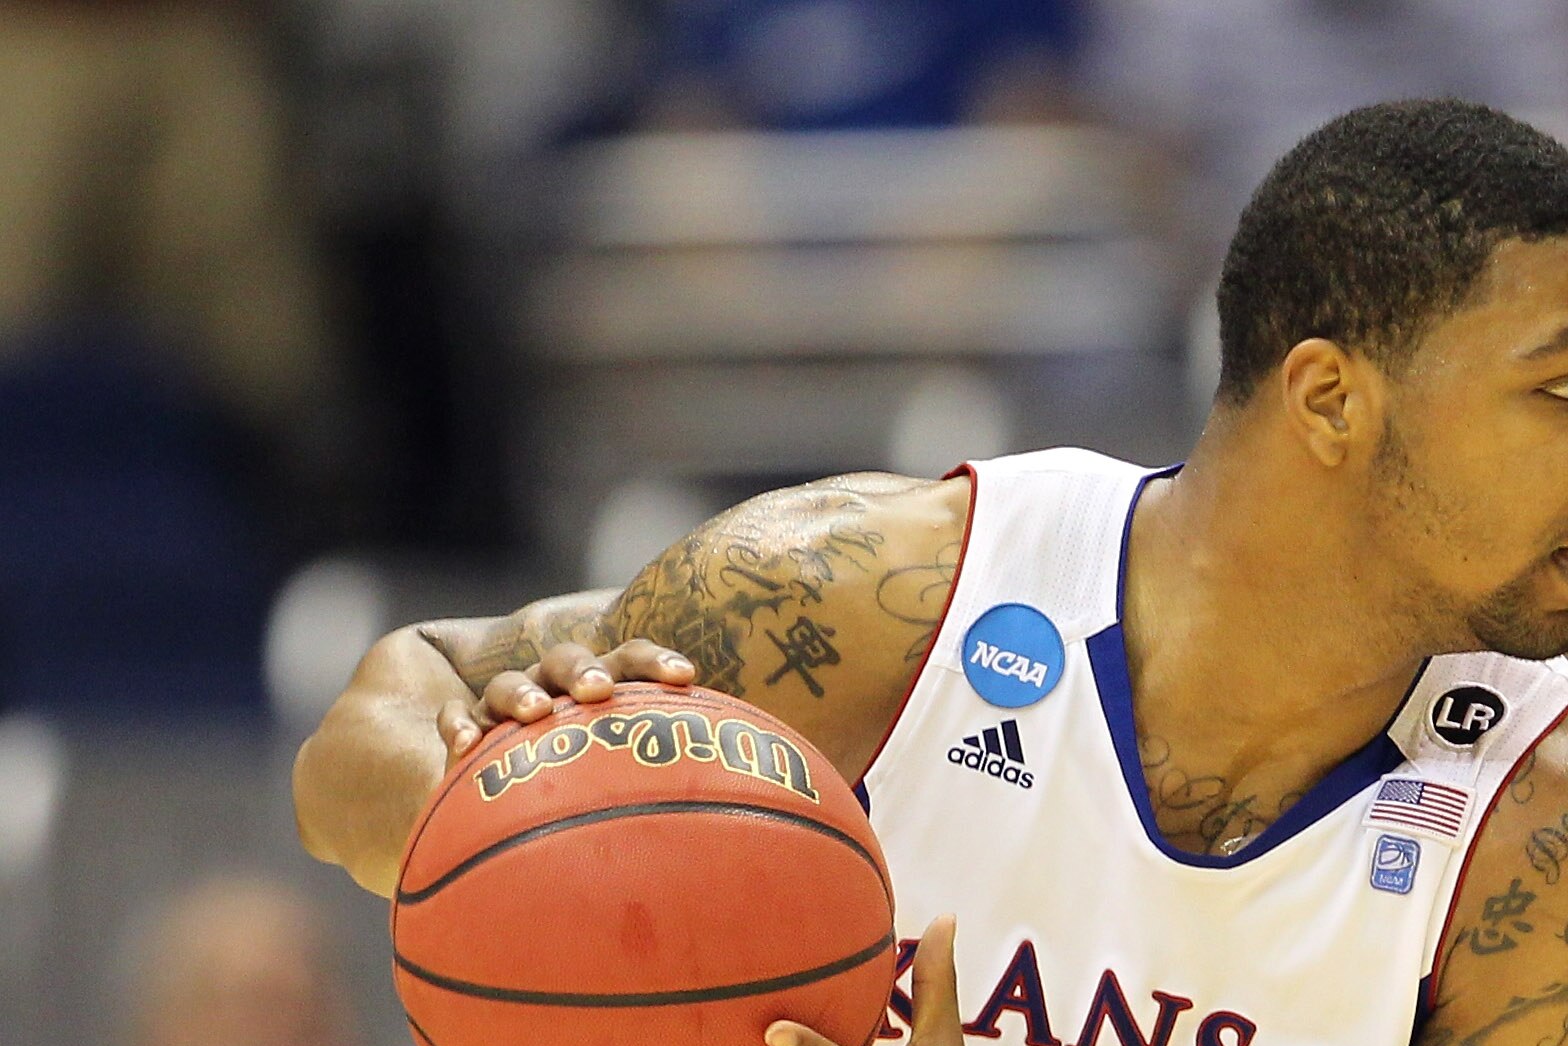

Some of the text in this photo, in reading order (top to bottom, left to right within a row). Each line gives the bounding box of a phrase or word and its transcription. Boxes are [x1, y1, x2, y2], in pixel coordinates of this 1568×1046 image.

[970, 640, 1048, 688] NCAA
[1436, 697, 1495, 730] LR
[473, 709, 820, 805] Wilson
[947, 747, 1034, 789] adidas
